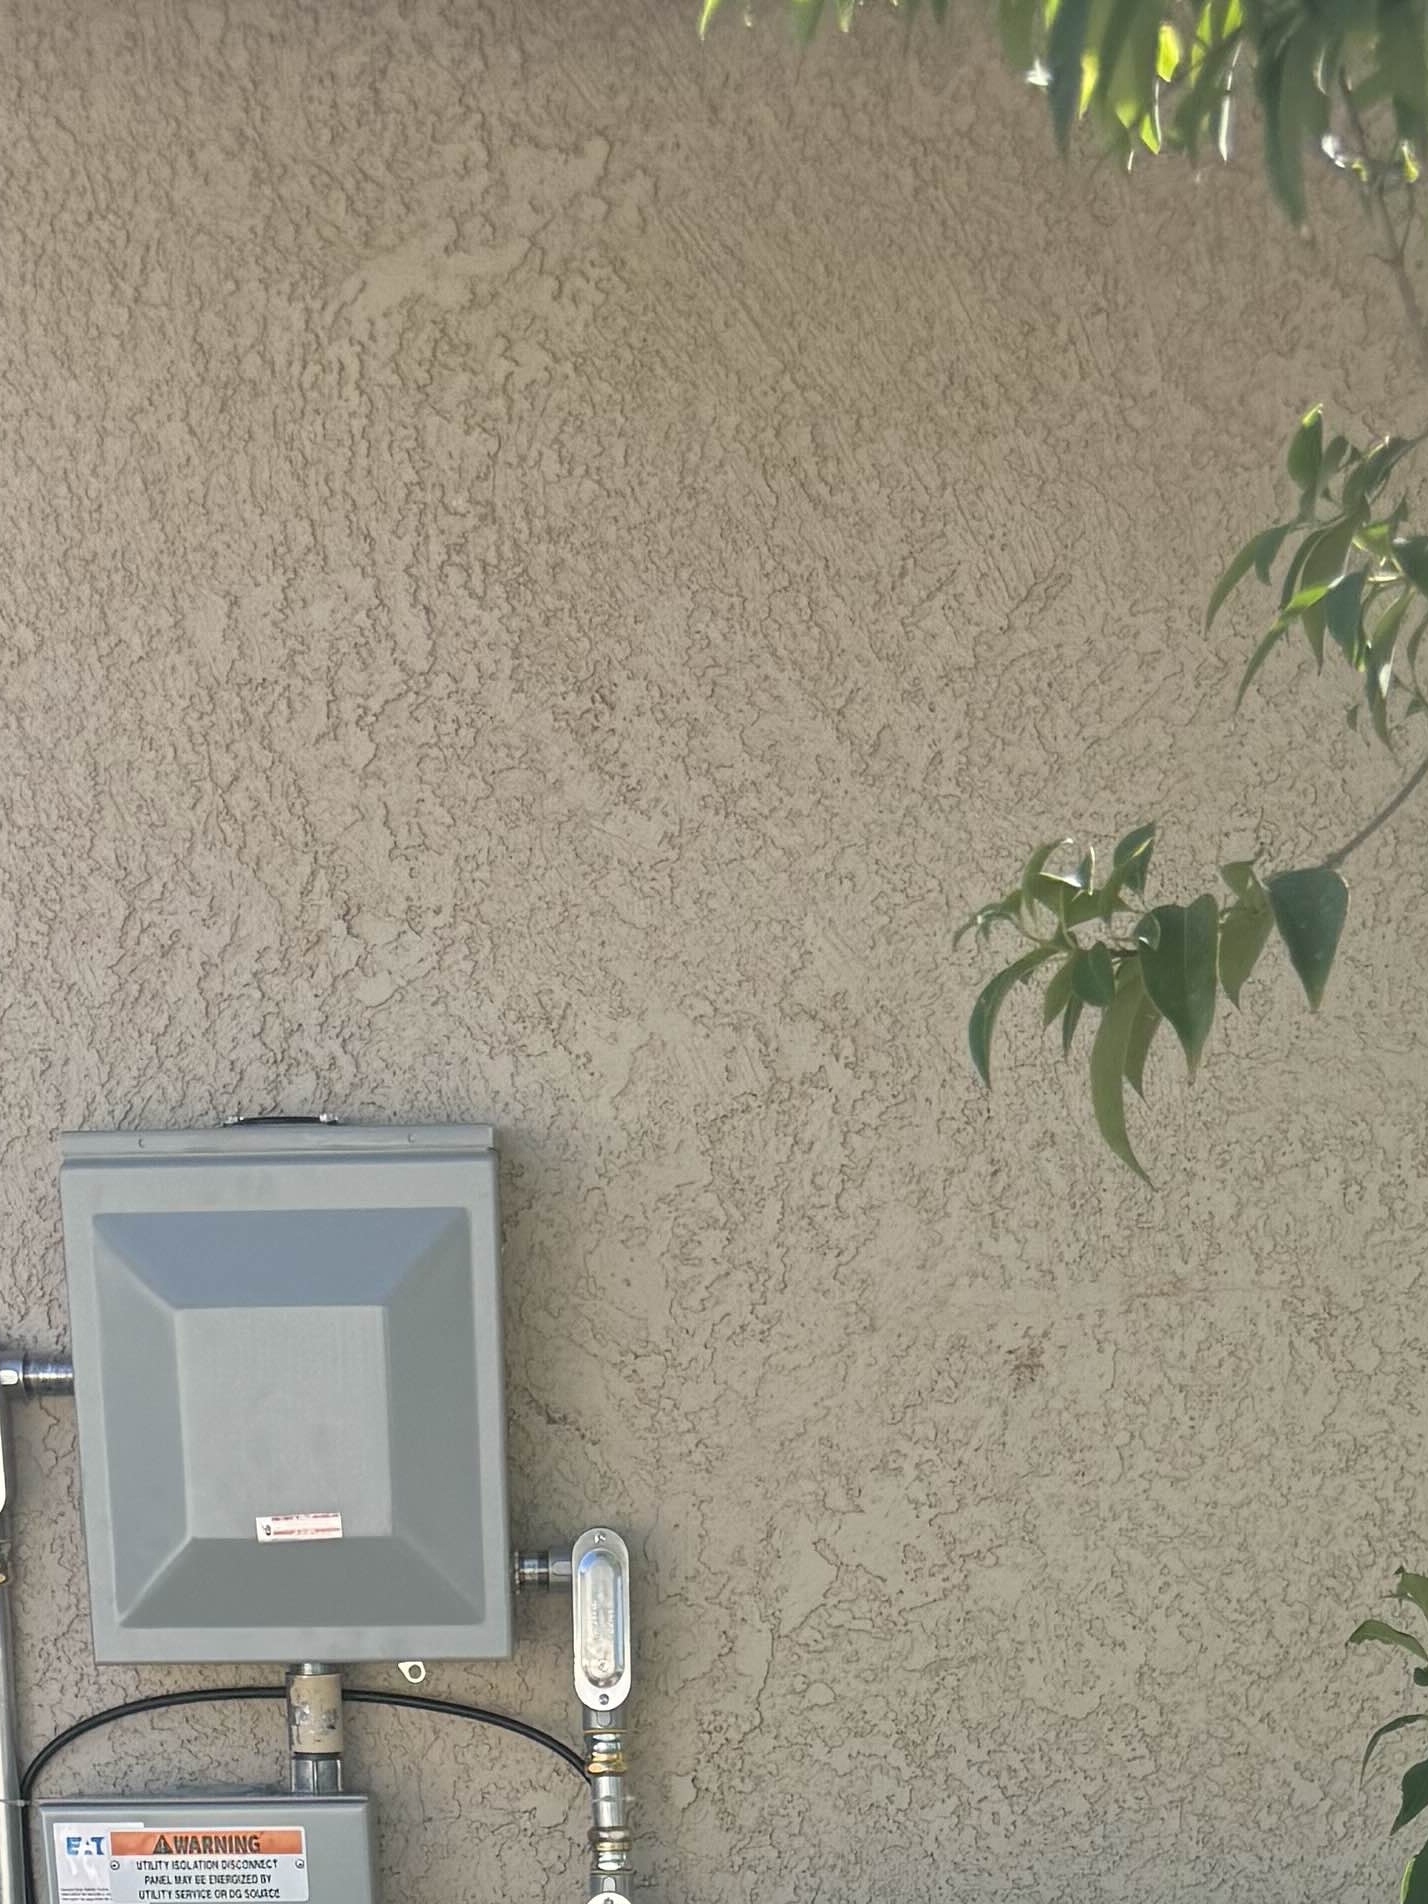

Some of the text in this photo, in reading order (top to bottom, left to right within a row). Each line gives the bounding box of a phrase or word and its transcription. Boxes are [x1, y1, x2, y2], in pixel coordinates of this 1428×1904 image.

[172, 1835, 261, 1855] WARNING
[136, 1859, 278, 1871] UTILITY ISOLATION DISCONNECT
[144, 1874, 272, 1886] PANEL MAY BE ENERGIZED BY
[138, 1888, 281, 1900] UTILITY SERVICE OR DG SOURCE
